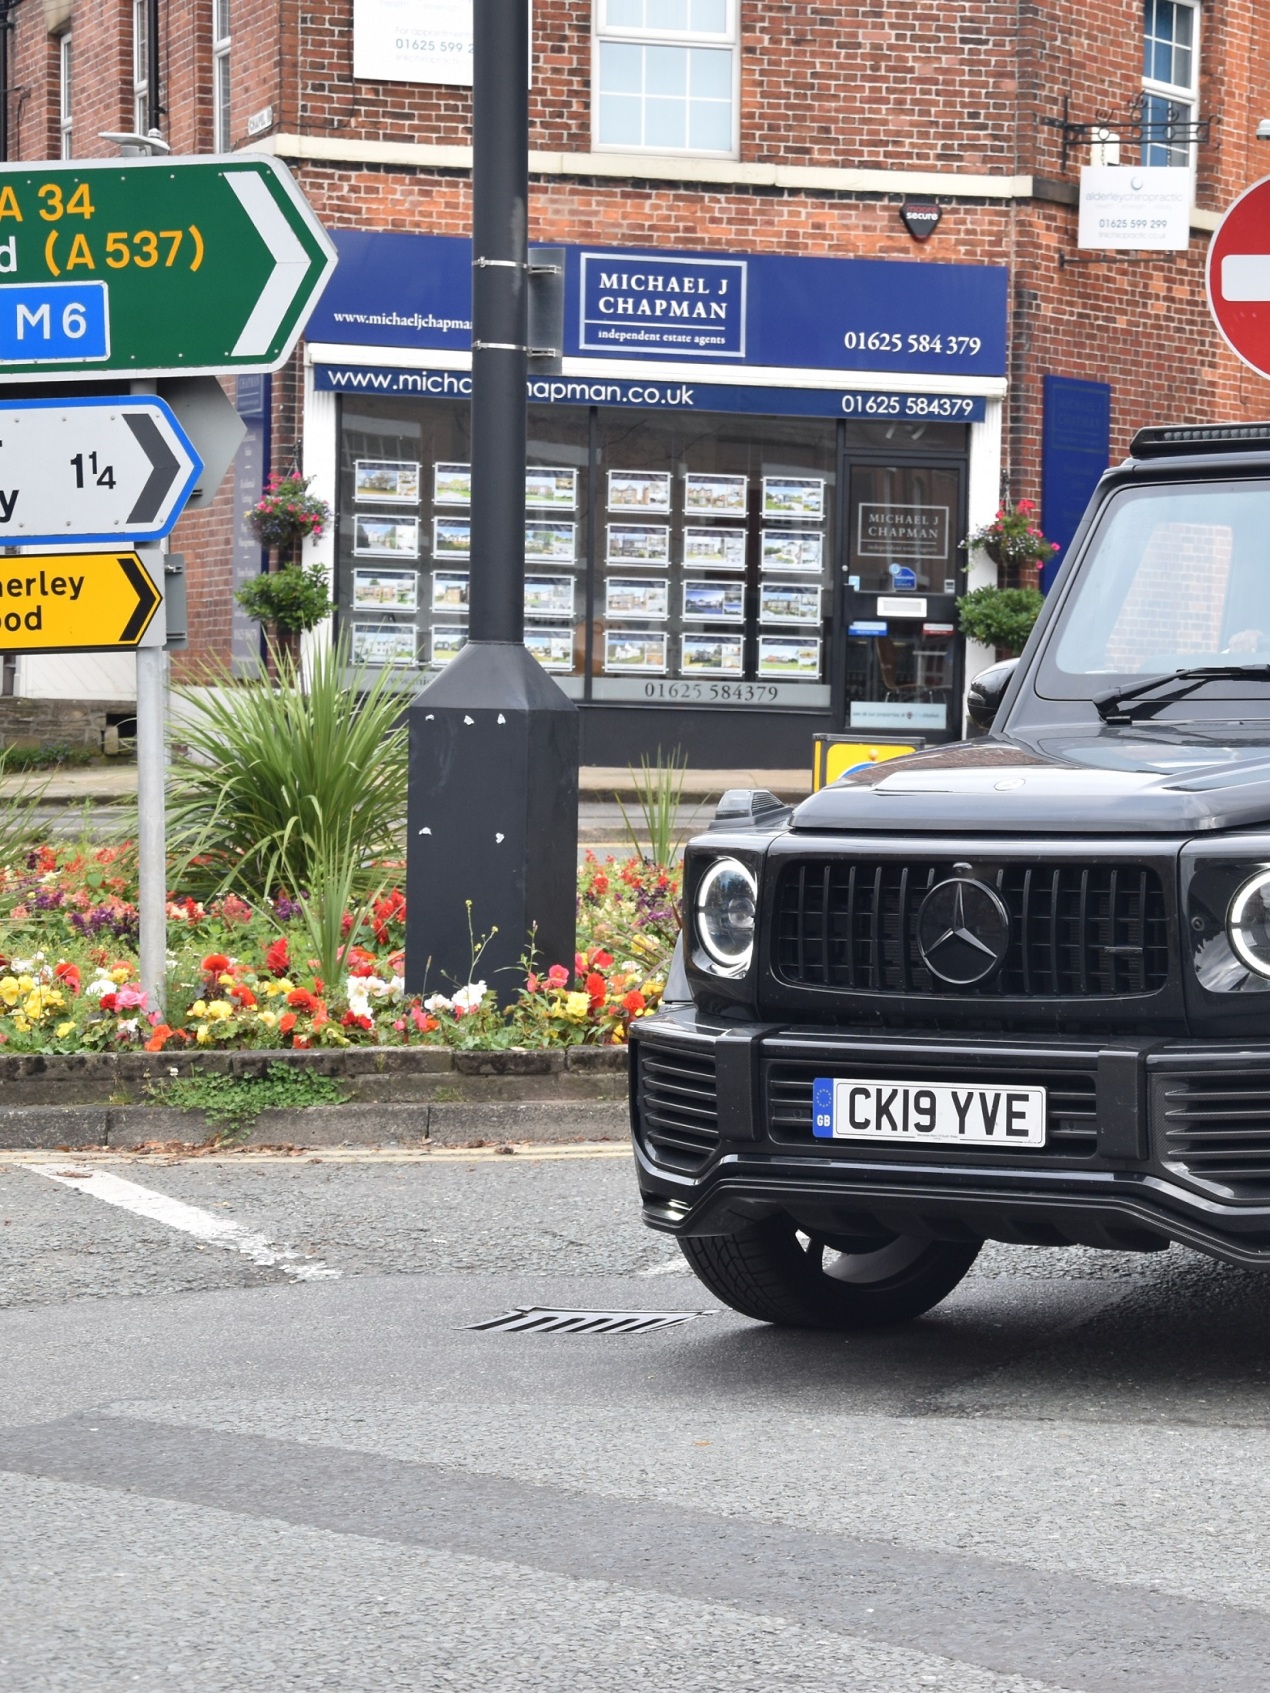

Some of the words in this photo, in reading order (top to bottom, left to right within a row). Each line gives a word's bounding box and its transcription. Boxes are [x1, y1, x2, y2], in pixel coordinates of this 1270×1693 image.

[395, 38, 435, 51] 01625
[440, 41, 464, 53] 599
[906, 212, 939, 221] secure
[1099, 219, 1128, 229] 01625
[1130, 219, 1148, 229] 599
[1150, 219, 1168, 229] 299
[598, 273, 710, 294] MICHAEL
[717, 279, 729, 295] J
[598, 296, 728, 319] CHAPMAN
[333, 312, 473, 332] www.michaeljchapma
[598, 329, 661, 342] independent
[662, 333, 692, 343] estate
[693, 335, 726, 346] agents
[844, 331, 903, 352] 01625
[907, 334, 943, 353] 584
[946, 336, 982, 355] 379
[842, 395, 900, 414] 01625
[905, 397, 974, 416] 584379
[868, 513, 929, 525] MICHAEL
[933, 516, 939, 525] J
[868, 526, 939, 538] CHAPMAN
[645, 682, 702, 699] 01625
[709, 684, 778, 701] 584379
[817, 1114, 831, 1127] GB
[850, 1087, 936, 1133] CK19
[951, 1091, 1029, 1137] YVE
